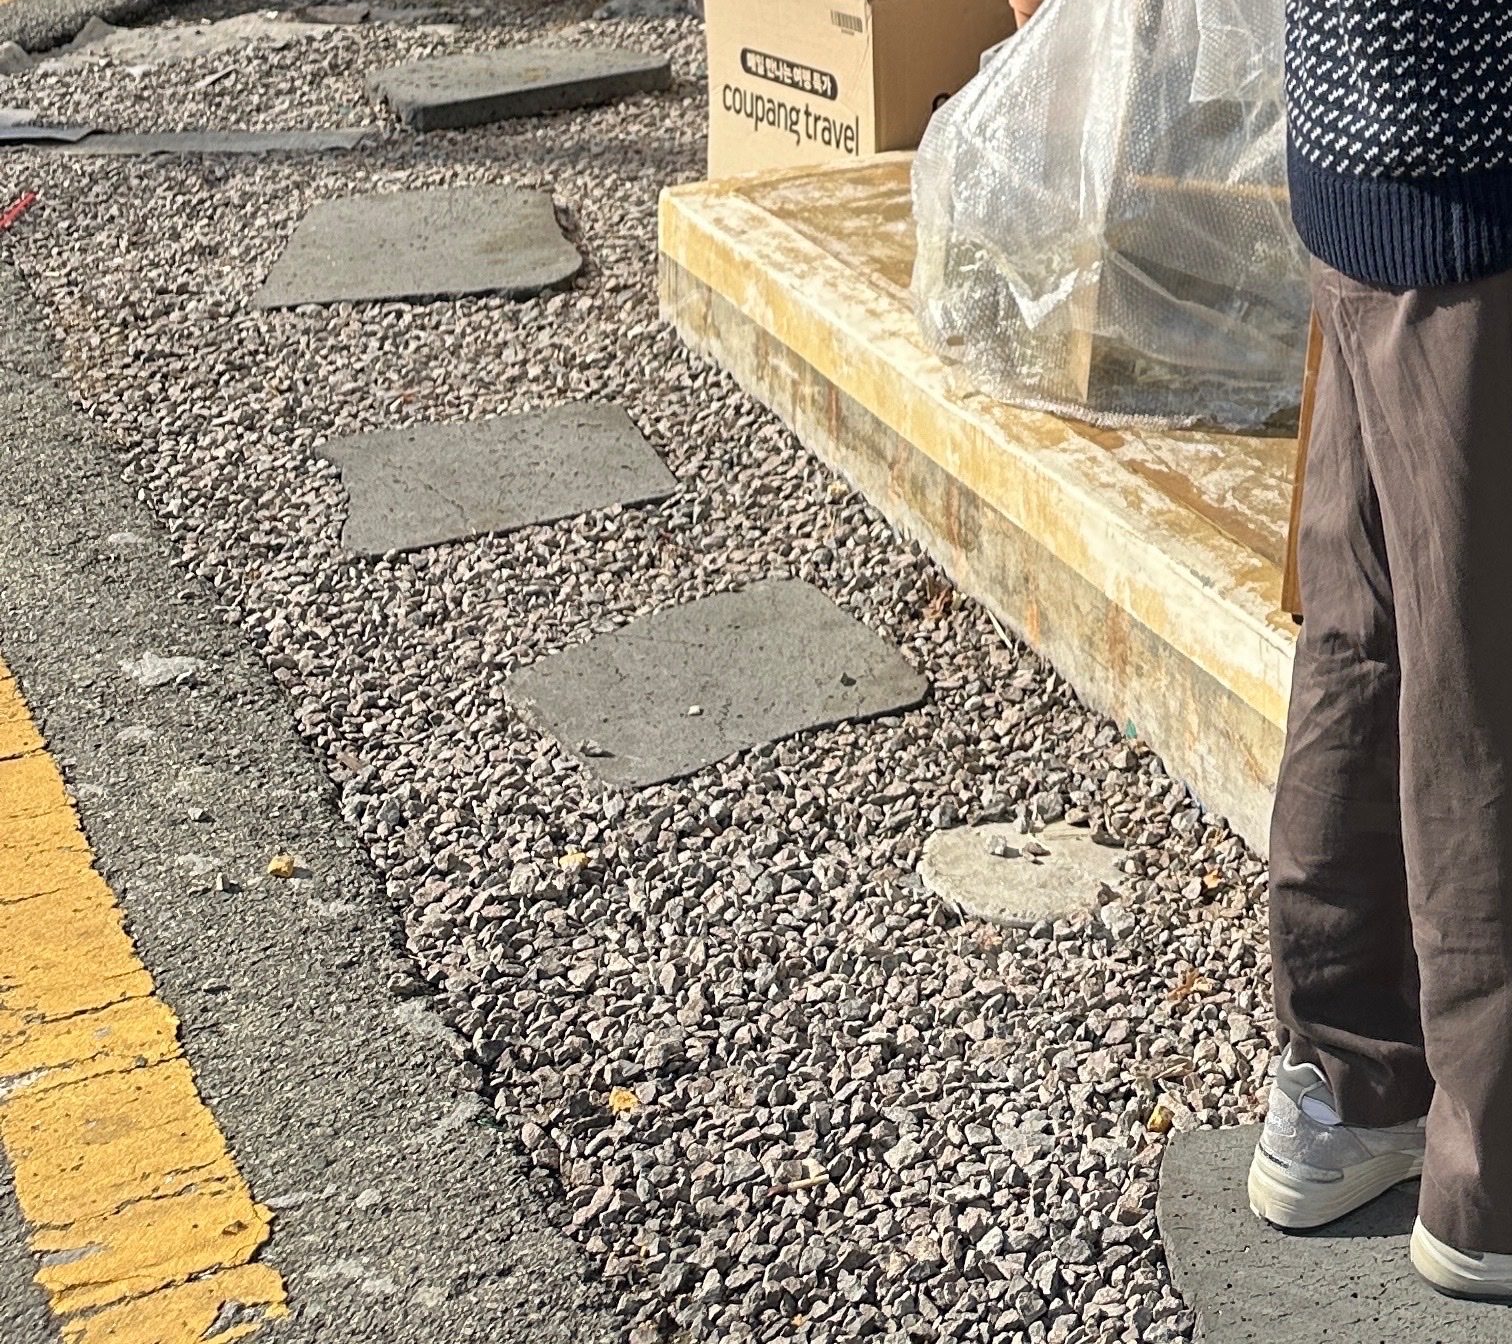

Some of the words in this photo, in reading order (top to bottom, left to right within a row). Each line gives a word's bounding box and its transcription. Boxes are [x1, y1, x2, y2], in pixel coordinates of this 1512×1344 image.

[746, 52, 765, 76] 매일
[765, 58, 793, 84] 만나는
[793, 66, 812, 90] 여행
[813, 71, 832, 96] 특가
[722, 83, 801, 147] coupang
[804, 103, 859, 157] travel
